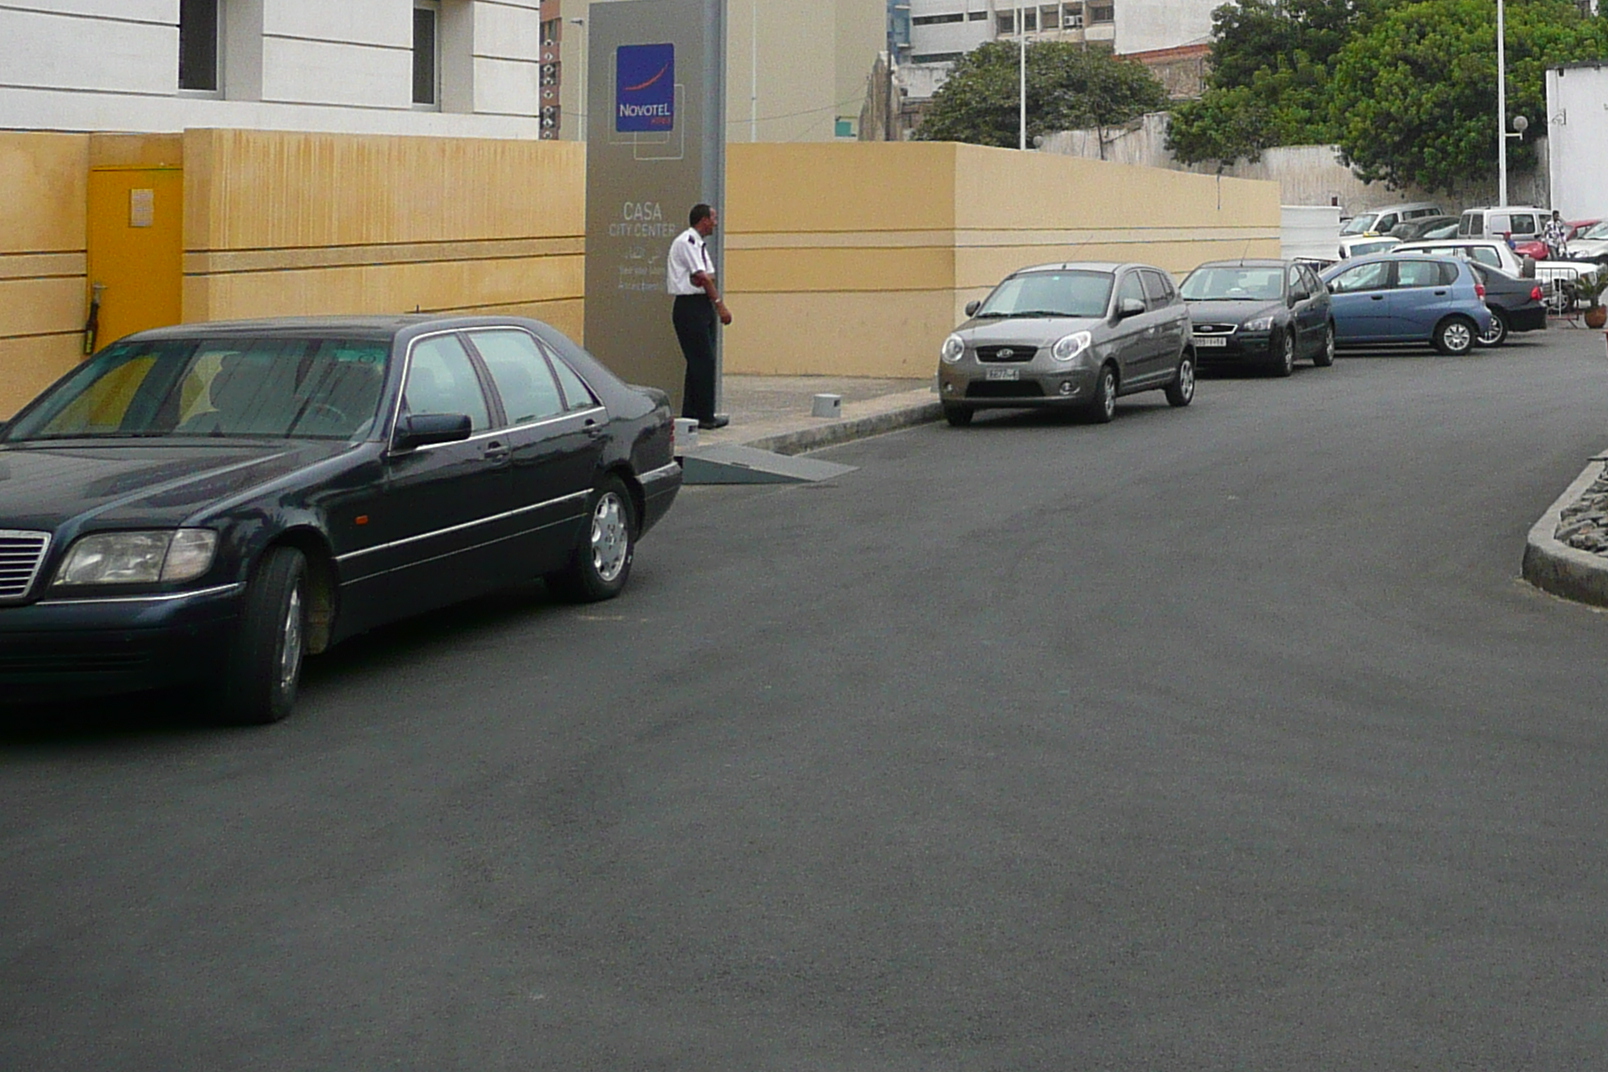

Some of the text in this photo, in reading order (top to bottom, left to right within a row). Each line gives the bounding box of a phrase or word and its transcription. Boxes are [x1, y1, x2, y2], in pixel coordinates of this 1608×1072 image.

[620, 103, 670, 117] NOVOTEL
[623, 201, 662, 221] CASA
[609, 222, 676, 237] CITY CENTER
